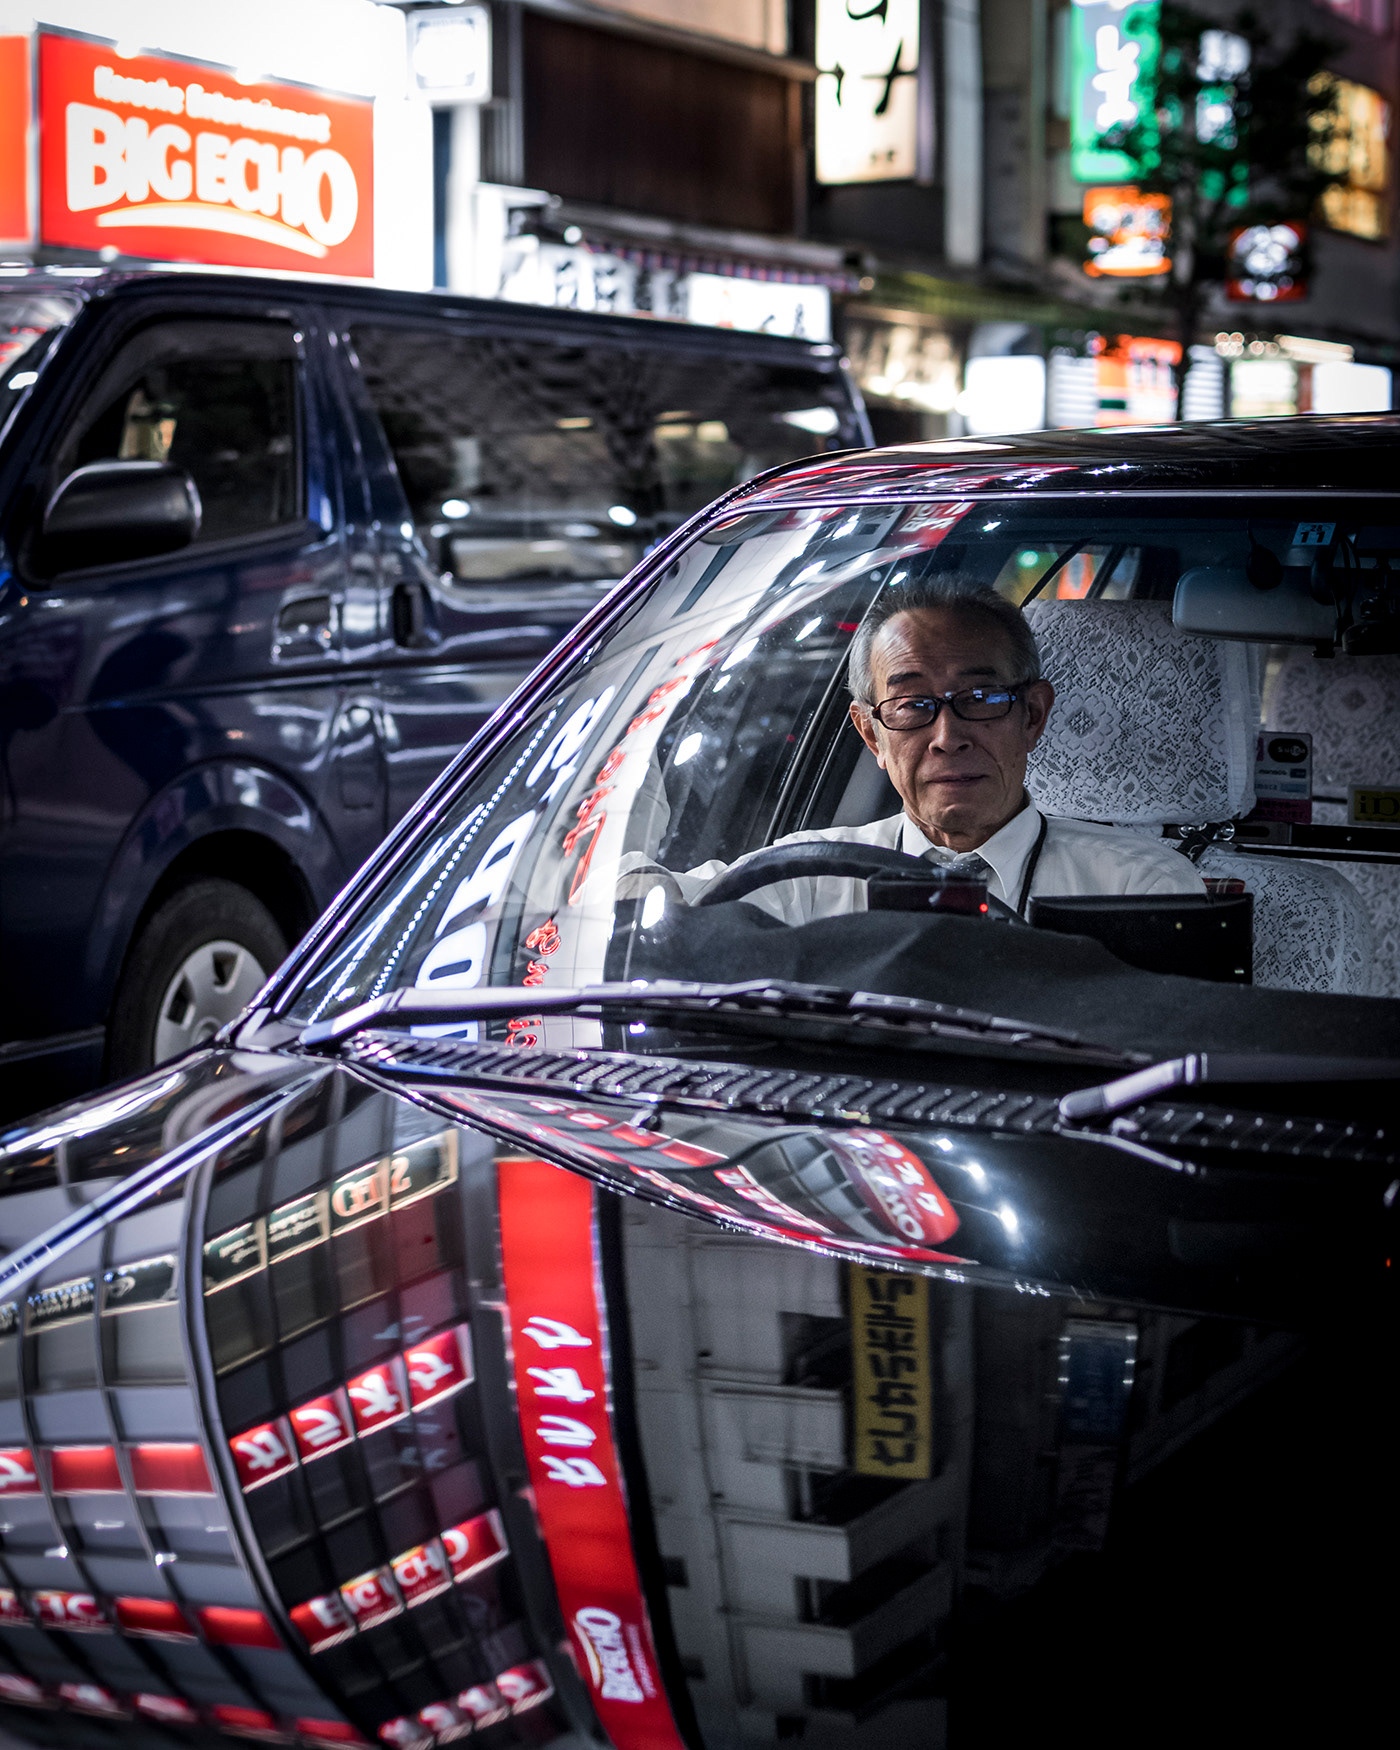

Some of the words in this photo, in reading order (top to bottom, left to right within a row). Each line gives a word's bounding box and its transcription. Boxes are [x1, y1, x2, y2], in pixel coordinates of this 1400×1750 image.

[66, 102, 192, 213] BIG
[196, 132, 358, 247] ECHO
[1300, 531, 1326, 543] 11
[1360, 795, 1399, 816] iD
